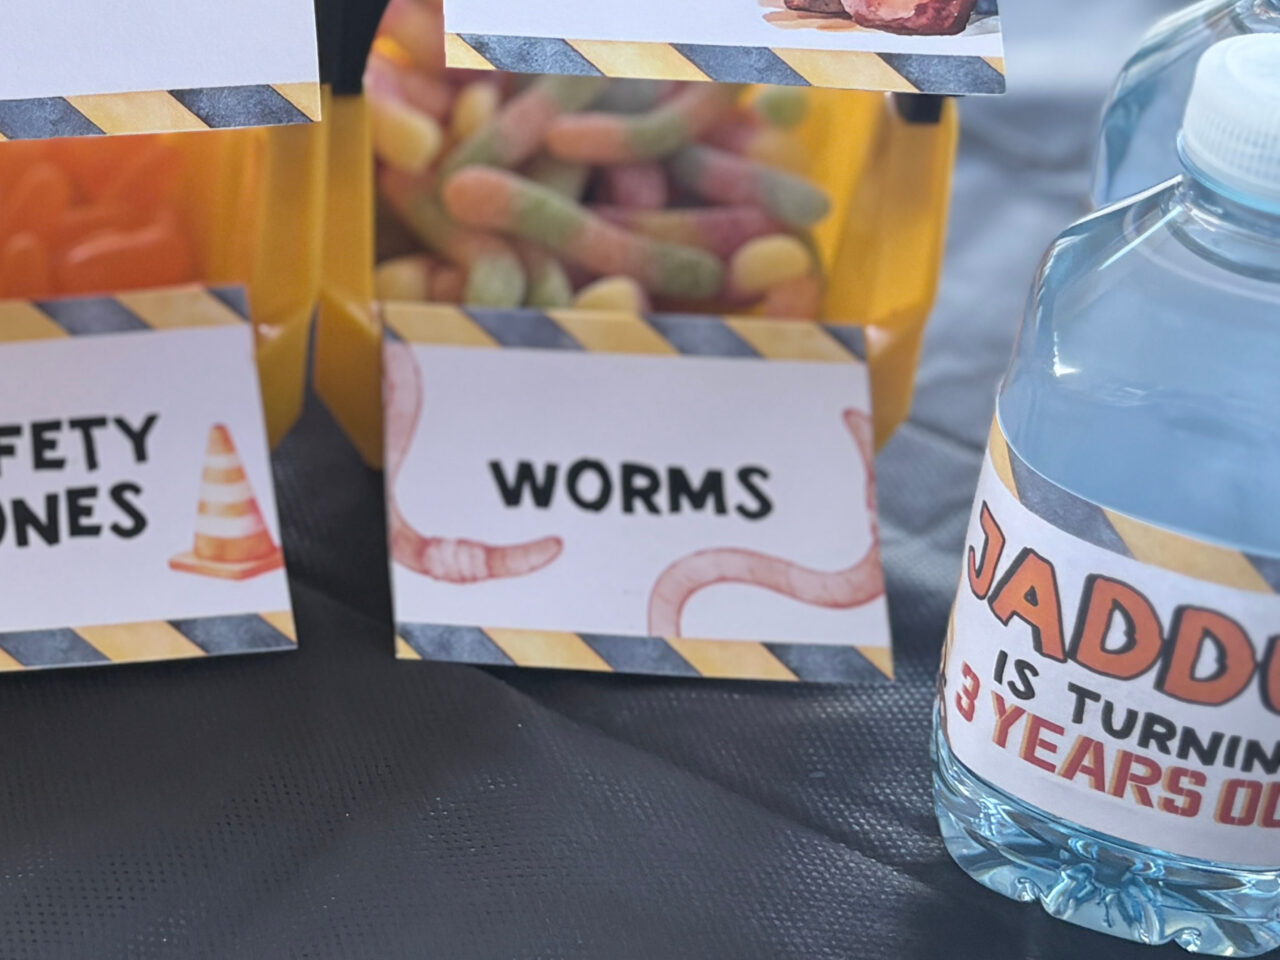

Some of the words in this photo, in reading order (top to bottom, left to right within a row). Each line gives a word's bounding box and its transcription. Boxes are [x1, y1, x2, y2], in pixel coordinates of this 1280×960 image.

[488, 458, 774, 521] WORMS
[968, 500, 1280, 716] JADD
[993, 649, 1040, 701] IS
[955, 660, 980, 723] 3
[990, 689, 1208, 819] YEARS
